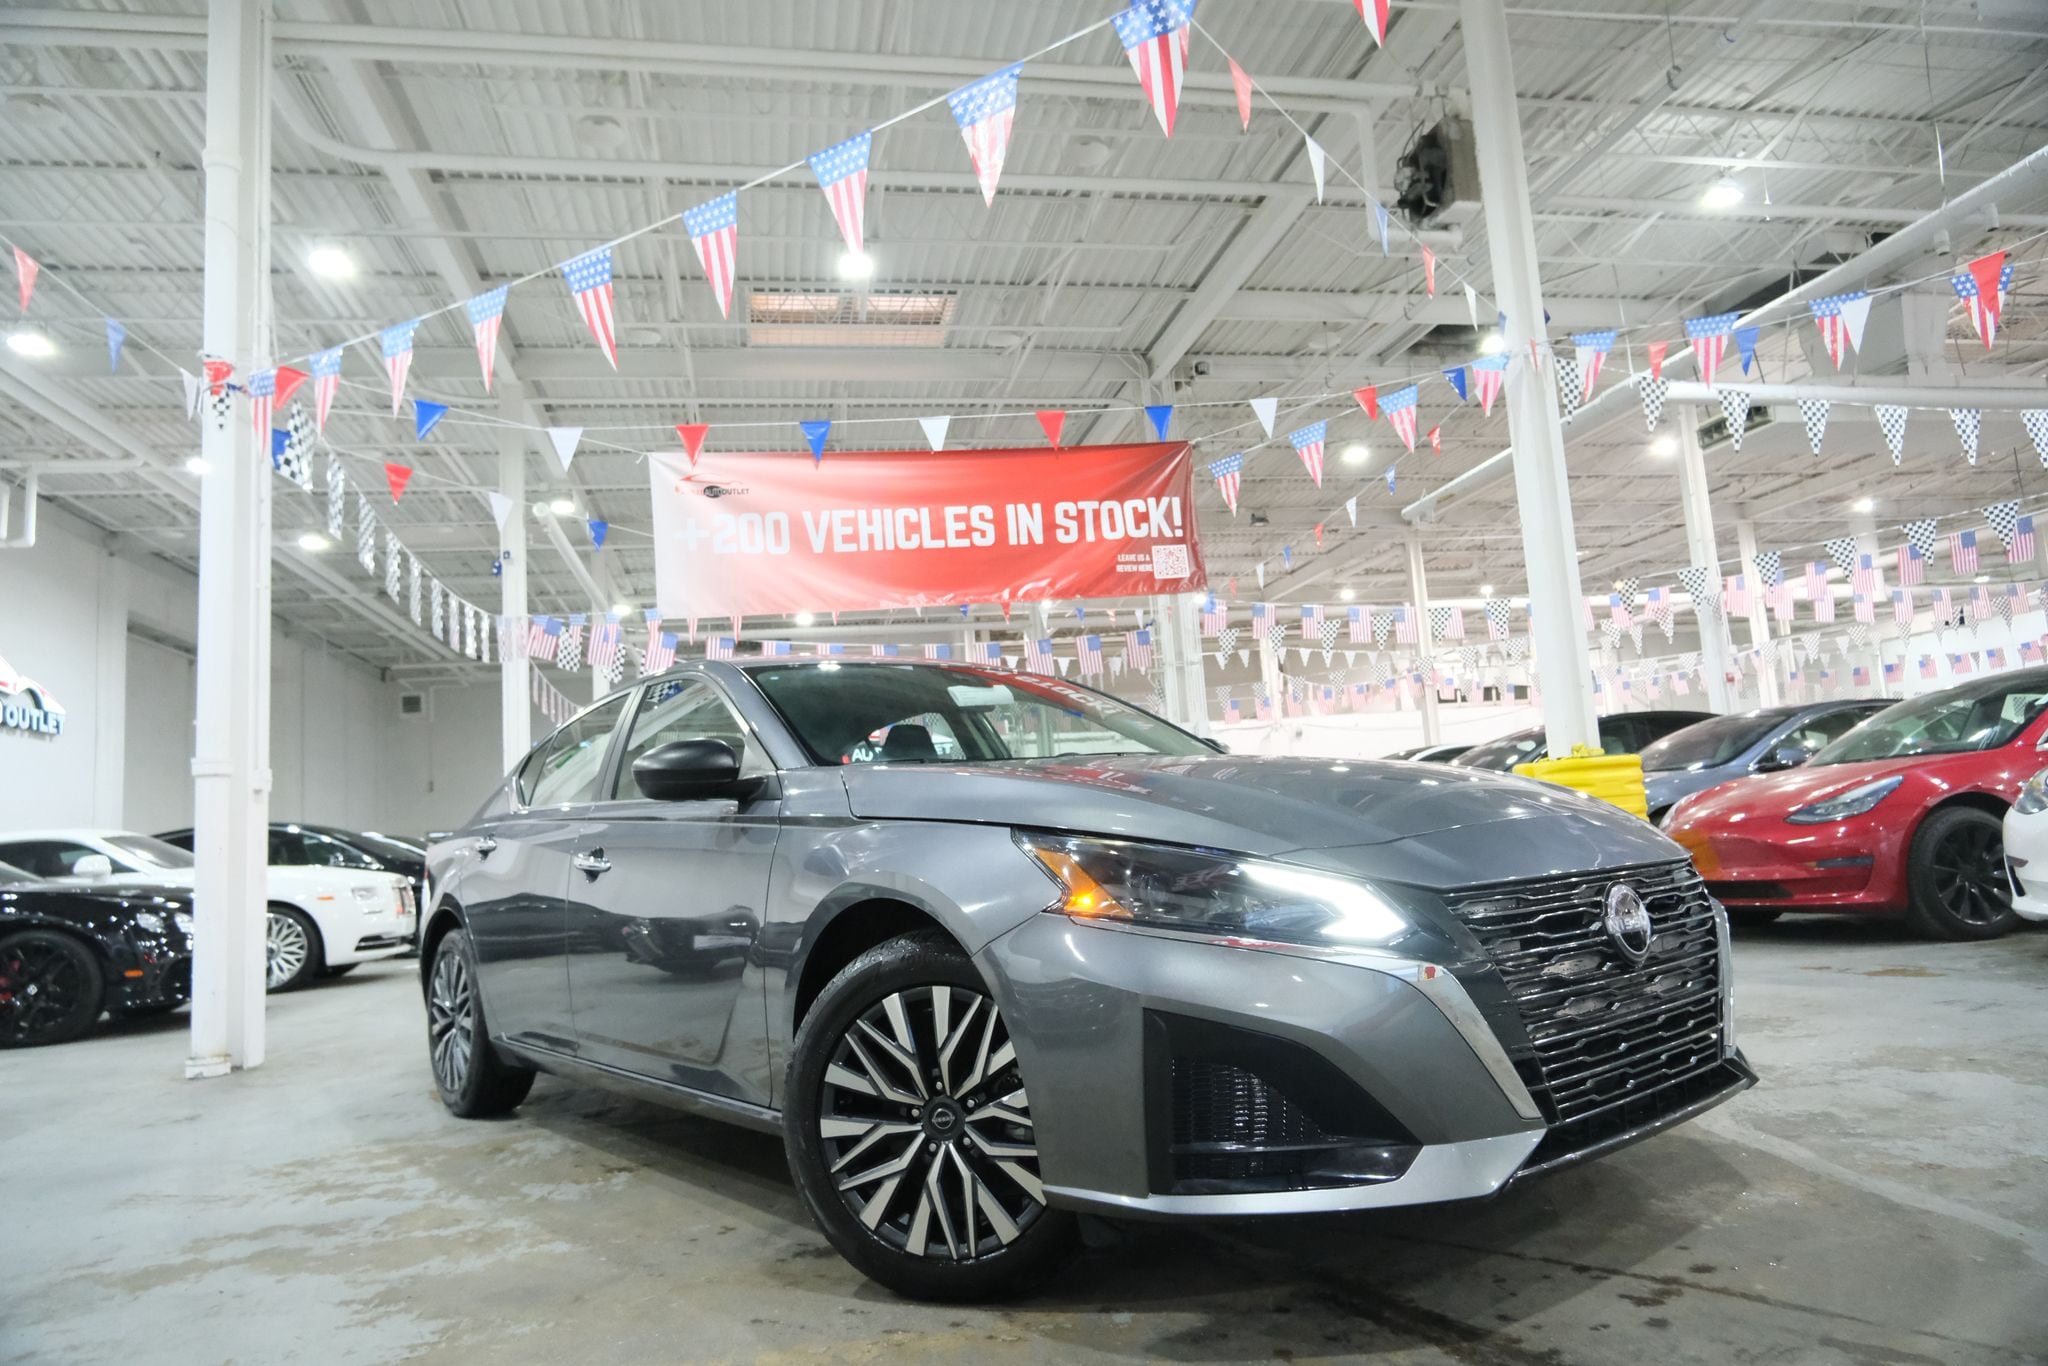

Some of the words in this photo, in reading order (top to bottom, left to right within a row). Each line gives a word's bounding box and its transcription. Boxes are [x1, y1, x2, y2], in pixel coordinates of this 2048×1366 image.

[721, 488, 750, 496] OUTLET
[675, 511, 791, 555] +200
[802, 505, 996, 554] VEHICLES
[1005, 502, 1044, 546] IN
[1054, 496, 1184, 544] STOCK!
[1117, 553, 1137, 562] LEAVE
[1145, 553, 1152, 561] A
[5, 704, 65, 735] OUTLET
